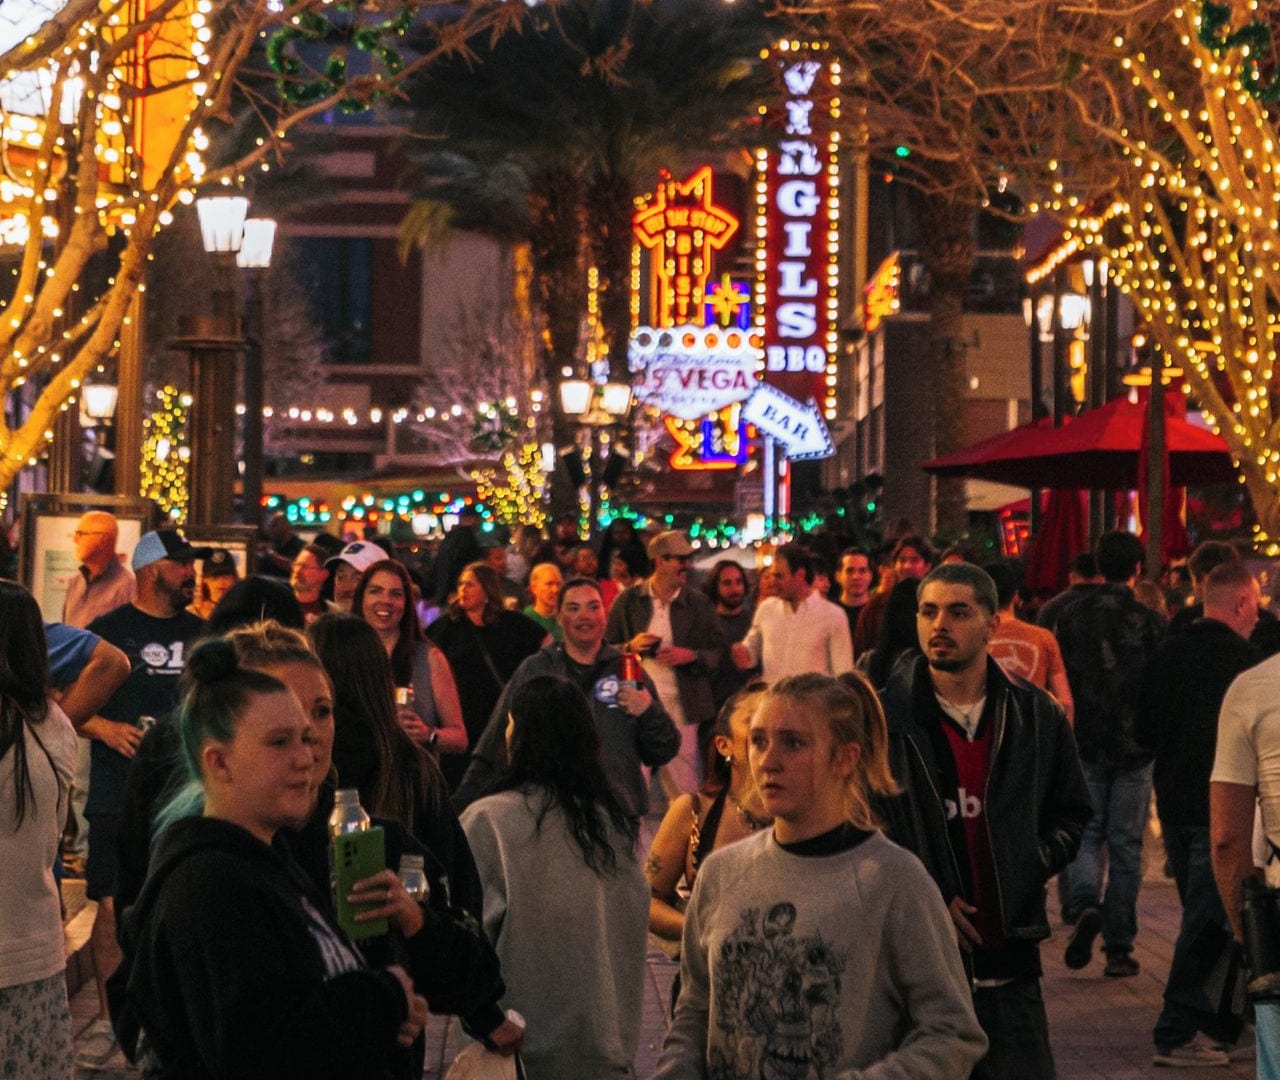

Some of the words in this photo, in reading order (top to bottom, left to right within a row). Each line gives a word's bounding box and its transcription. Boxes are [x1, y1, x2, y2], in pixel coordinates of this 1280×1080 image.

[775, 61, 822, 339] VIRGILS
[766, 345, 827, 373] BBQ
[678, 369, 760, 391] VEGA
[762, 404, 809, 440] BAR
[168, 641, 184, 668] 1
